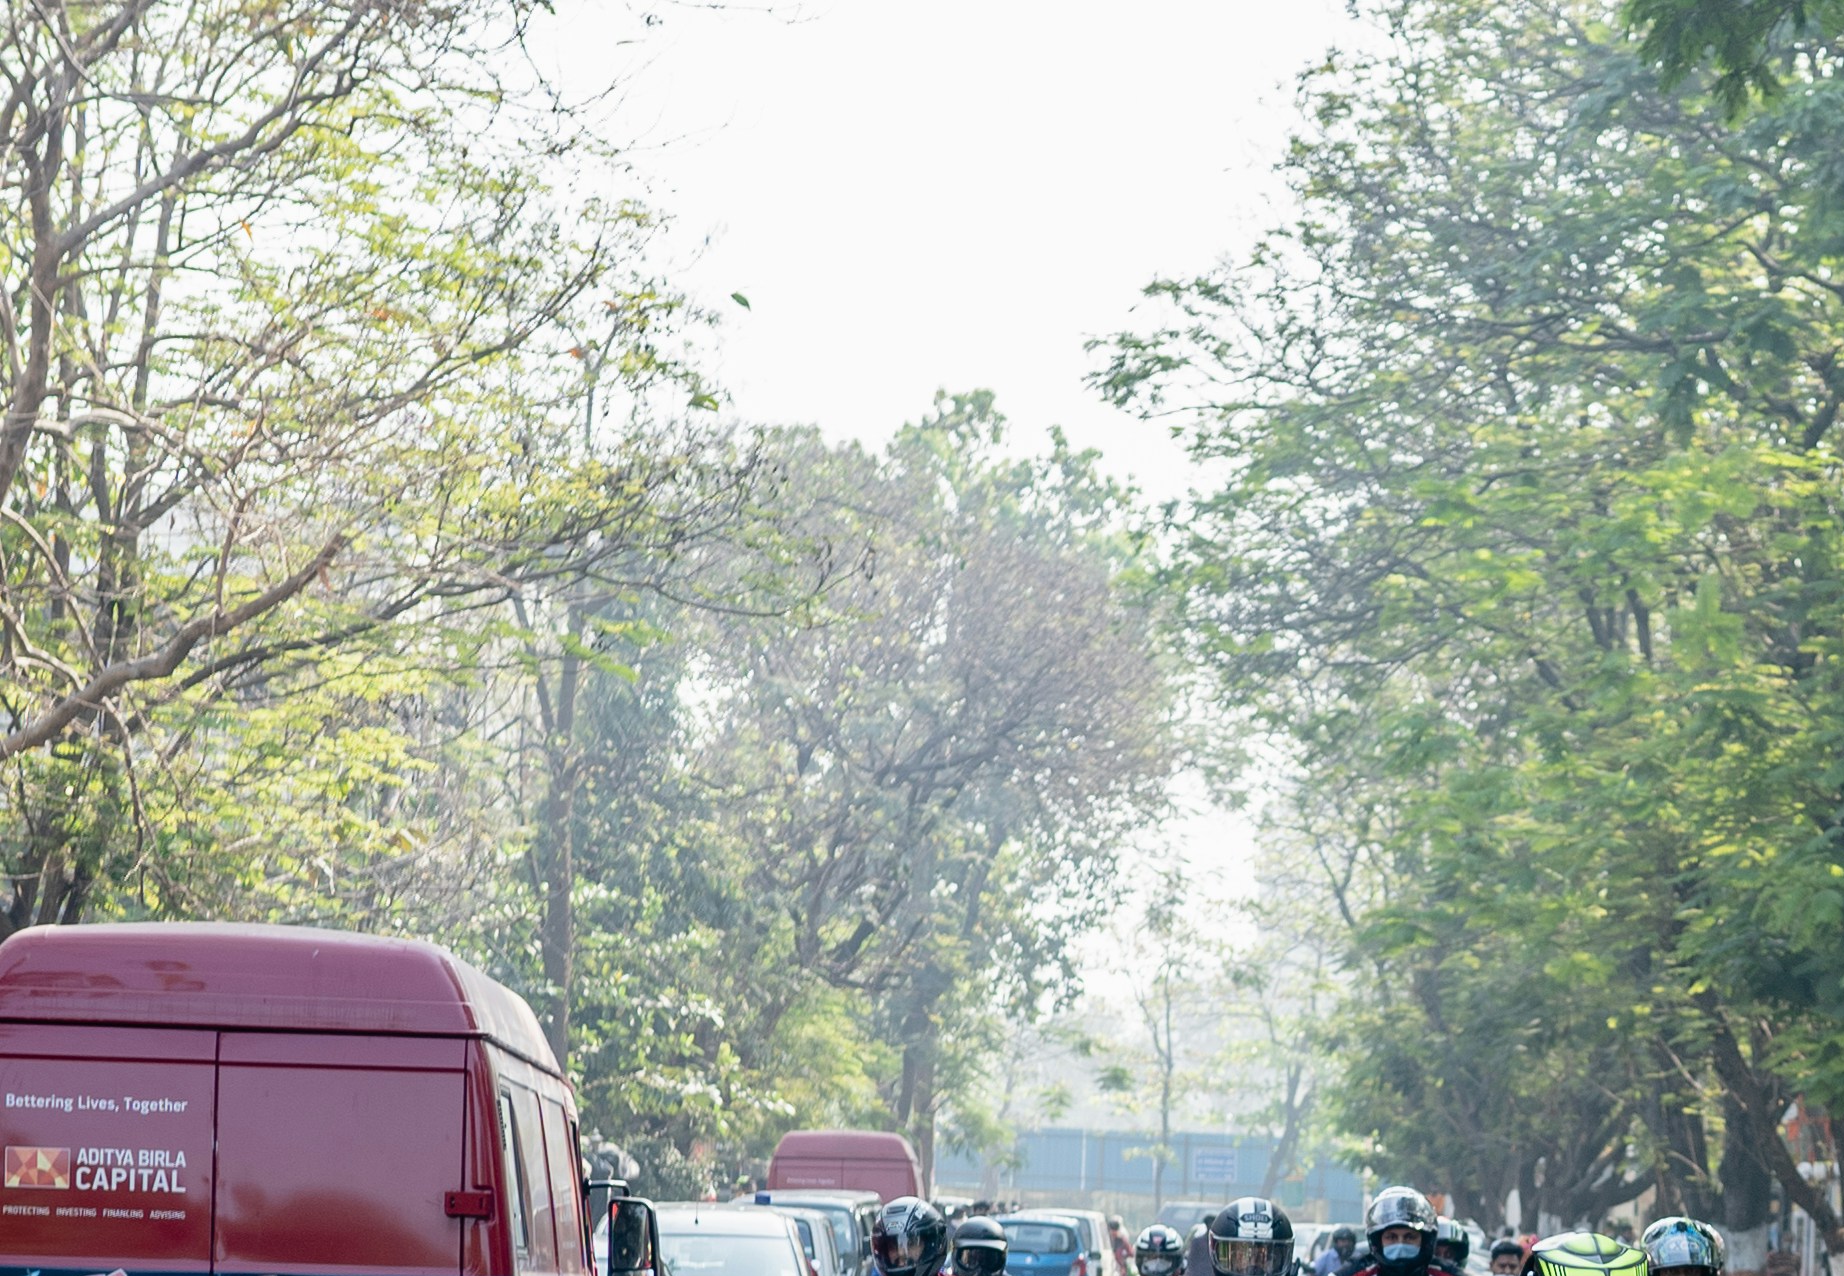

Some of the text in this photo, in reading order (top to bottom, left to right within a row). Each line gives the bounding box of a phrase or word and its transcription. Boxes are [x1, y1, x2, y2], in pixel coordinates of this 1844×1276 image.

[5, 1093, 188, 1115] Bettering Lives, Together
[77, 1148, 186, 1168] ADITYA BIRLA
[76, 1167, 187, 1193] CAPITAL
[2, 1205, 186, 1220] PROTECTING INVESTING FINANCING ADVISING
